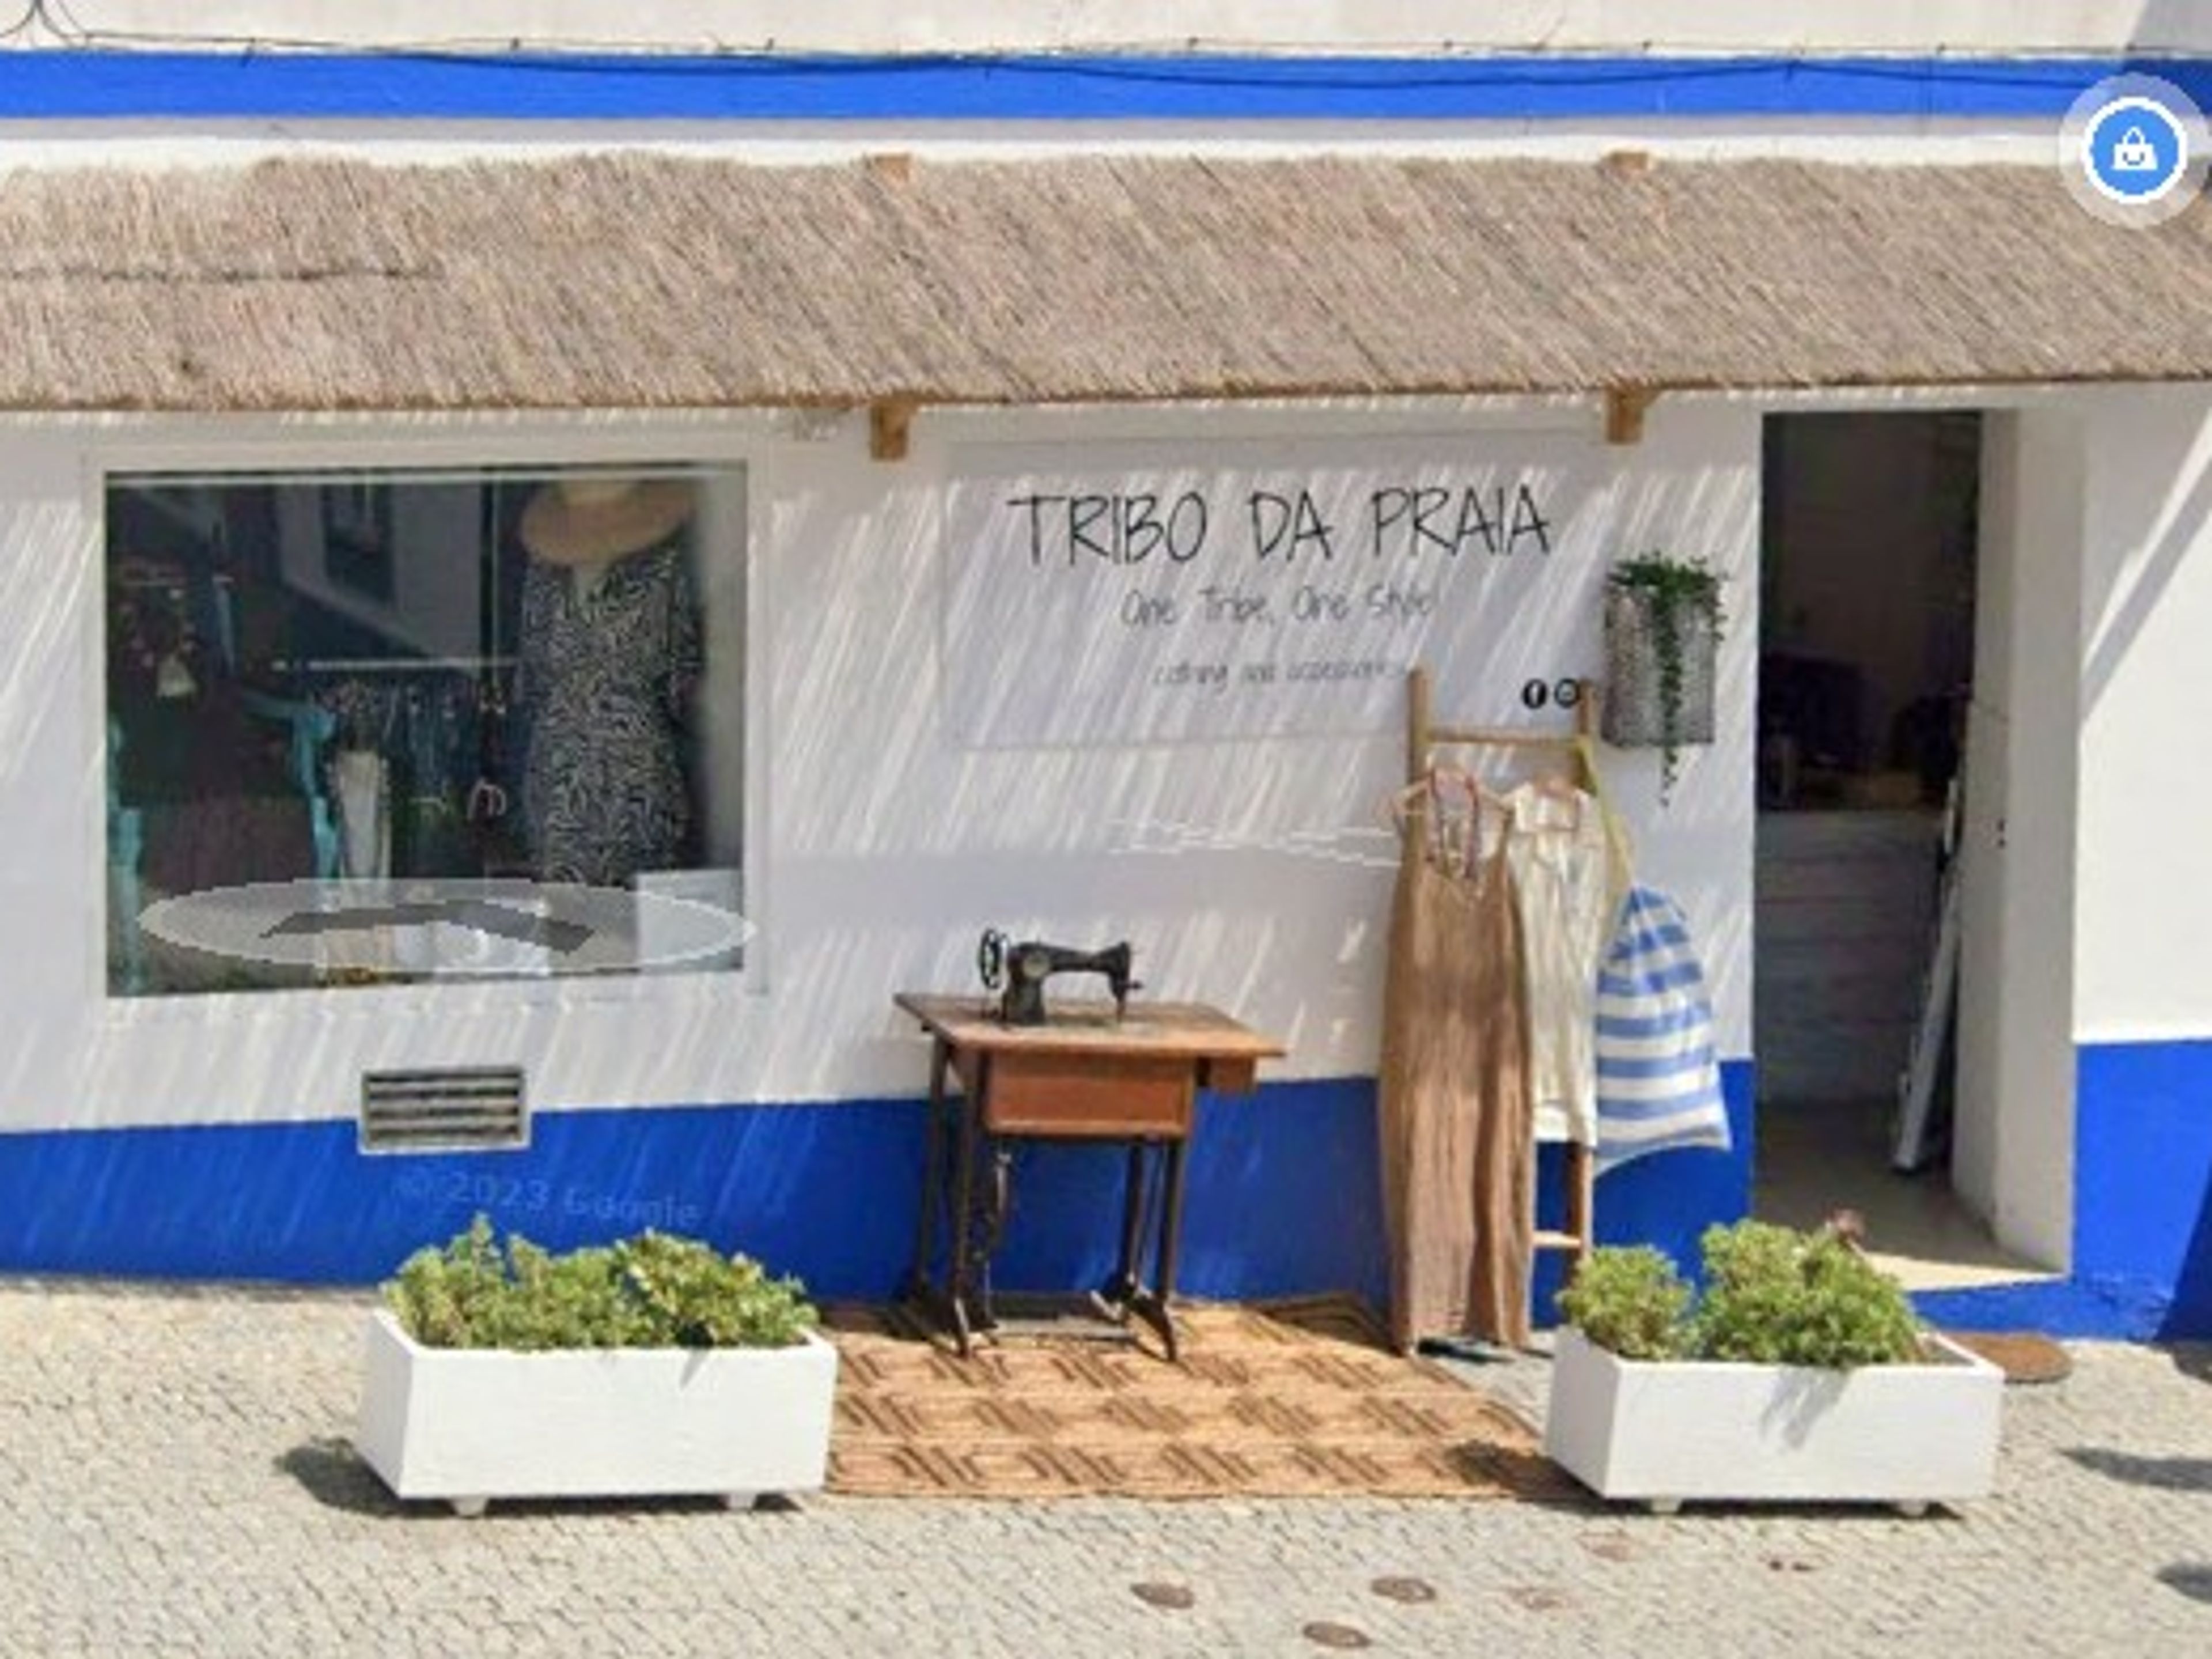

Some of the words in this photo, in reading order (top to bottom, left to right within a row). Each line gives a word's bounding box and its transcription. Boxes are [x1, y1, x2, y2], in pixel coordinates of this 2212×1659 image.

[1006, 491, 1207, 566] TRIBO
[1247, 490, 1334, 562] DA
[1371, 484, 1550, 556] PRAIA
[1121, 588, 1176, 627] One
[1292, 584, 1349, 620] One
